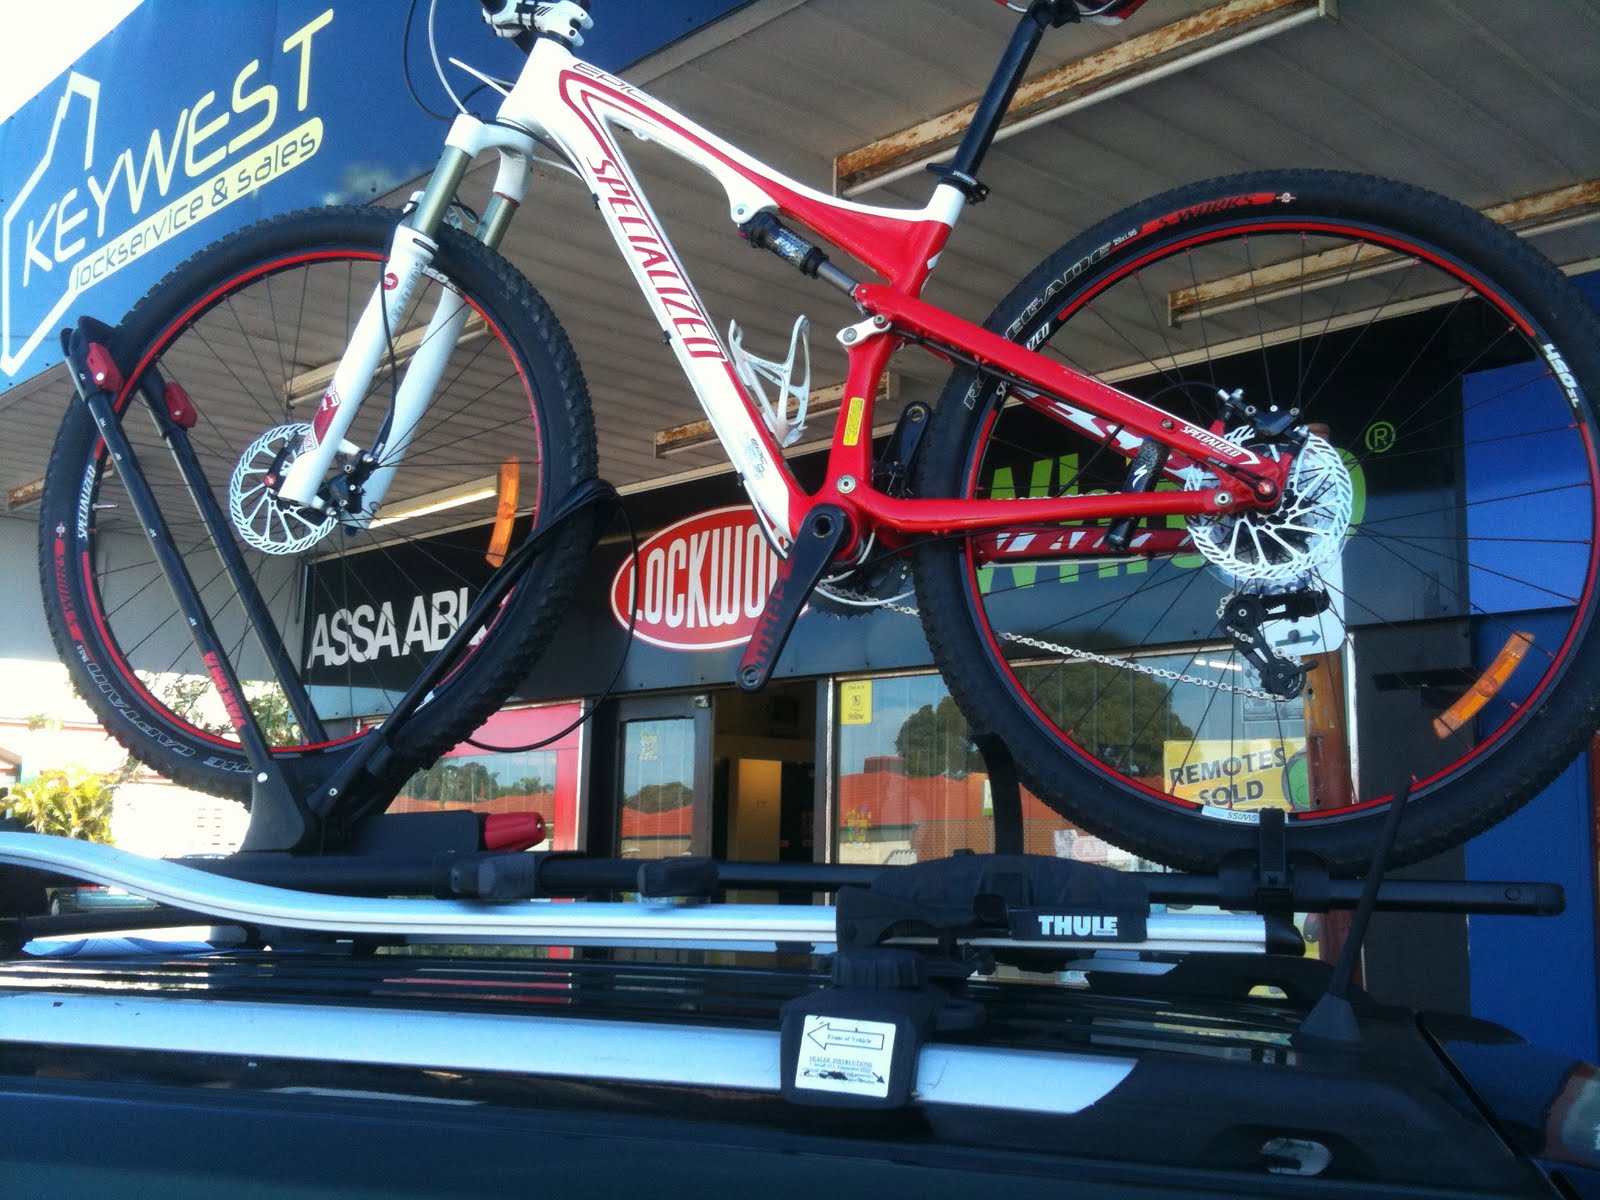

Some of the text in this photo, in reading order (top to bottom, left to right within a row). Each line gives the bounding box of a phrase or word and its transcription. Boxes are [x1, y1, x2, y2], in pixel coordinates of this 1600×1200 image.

[23, 8, 334, 287] KEYWEST
[75, 131, 316, 290] lockservice & sales
[586, 156, 726, 362] SPECIALIZED
[1180, 425, 1242, 458] SPECIALIZED
[306, 601, 400, 669] ASSA
[1169, 746, 1286, 785] REMOTES
[1199, 780, 1264, 806] SOLD
[1038, 915, 1118, 937] THULE
